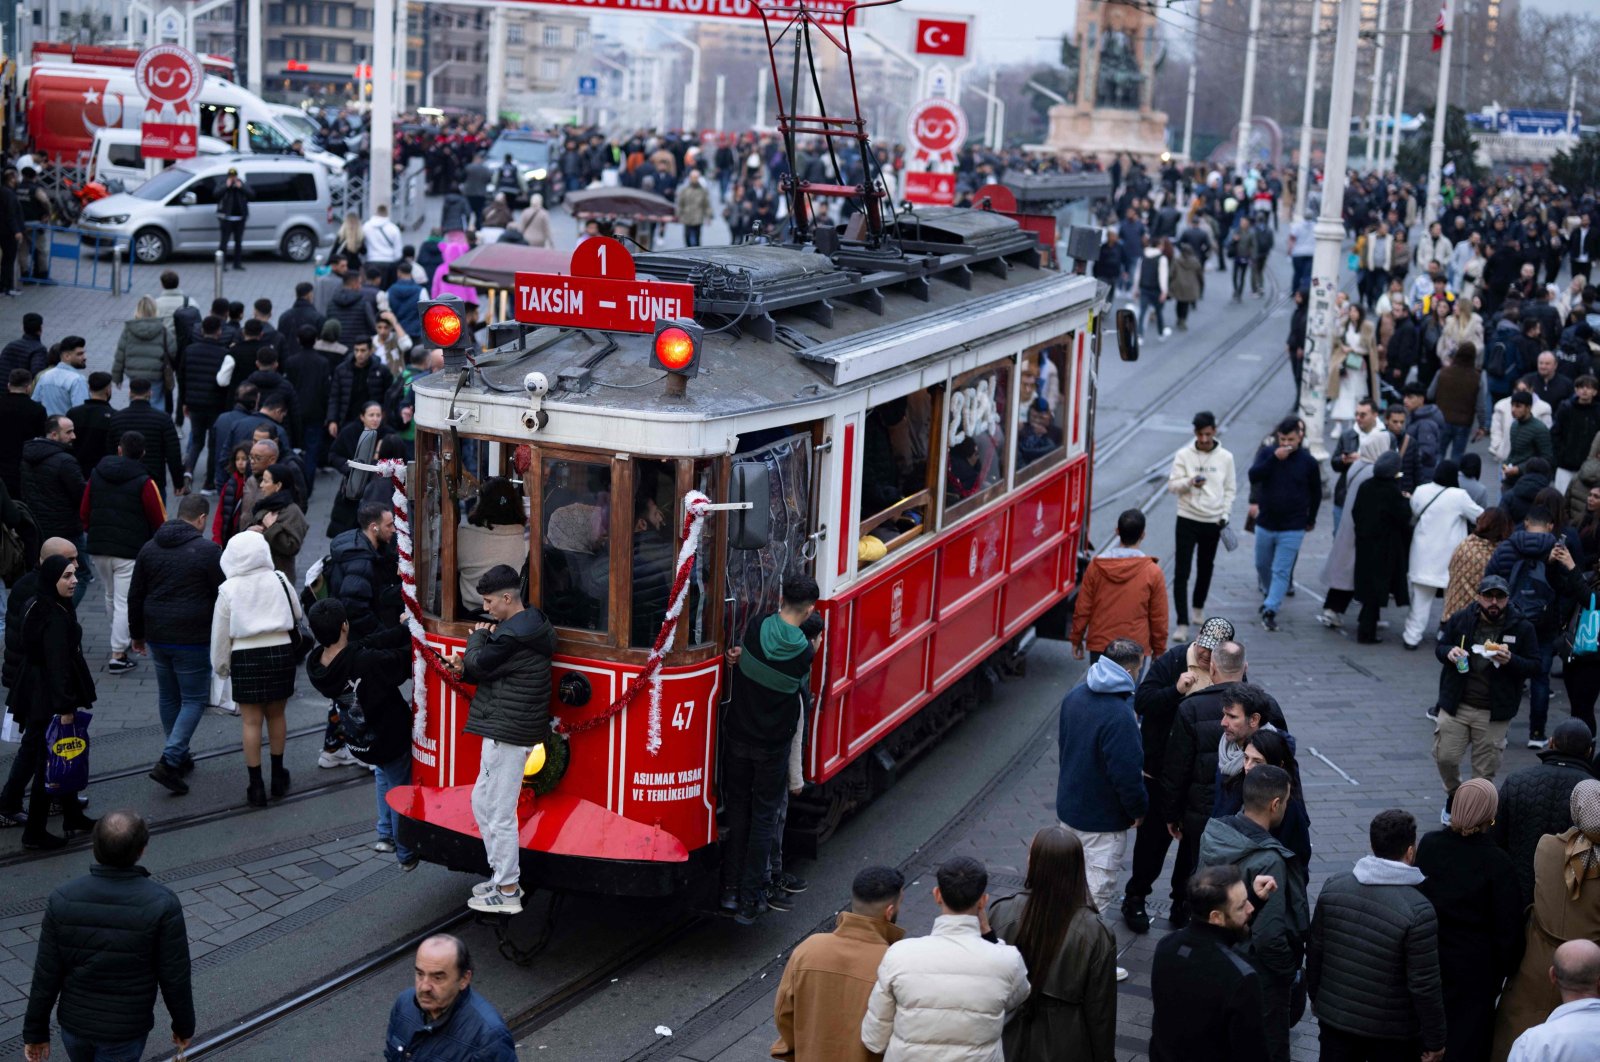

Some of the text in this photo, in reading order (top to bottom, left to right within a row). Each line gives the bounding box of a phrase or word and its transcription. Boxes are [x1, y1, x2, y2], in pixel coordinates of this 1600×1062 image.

[597, 244, 607, 276] 1
[519, 282, 584, 315] TAKSİM
[671, 700, 695, 731] 47
[57, 739, 82, 753] gratis
[633, 767, 703, 786] ASILMAK YASAK
[632, 783, 701, 802] VE TEHLİKELİDİR
